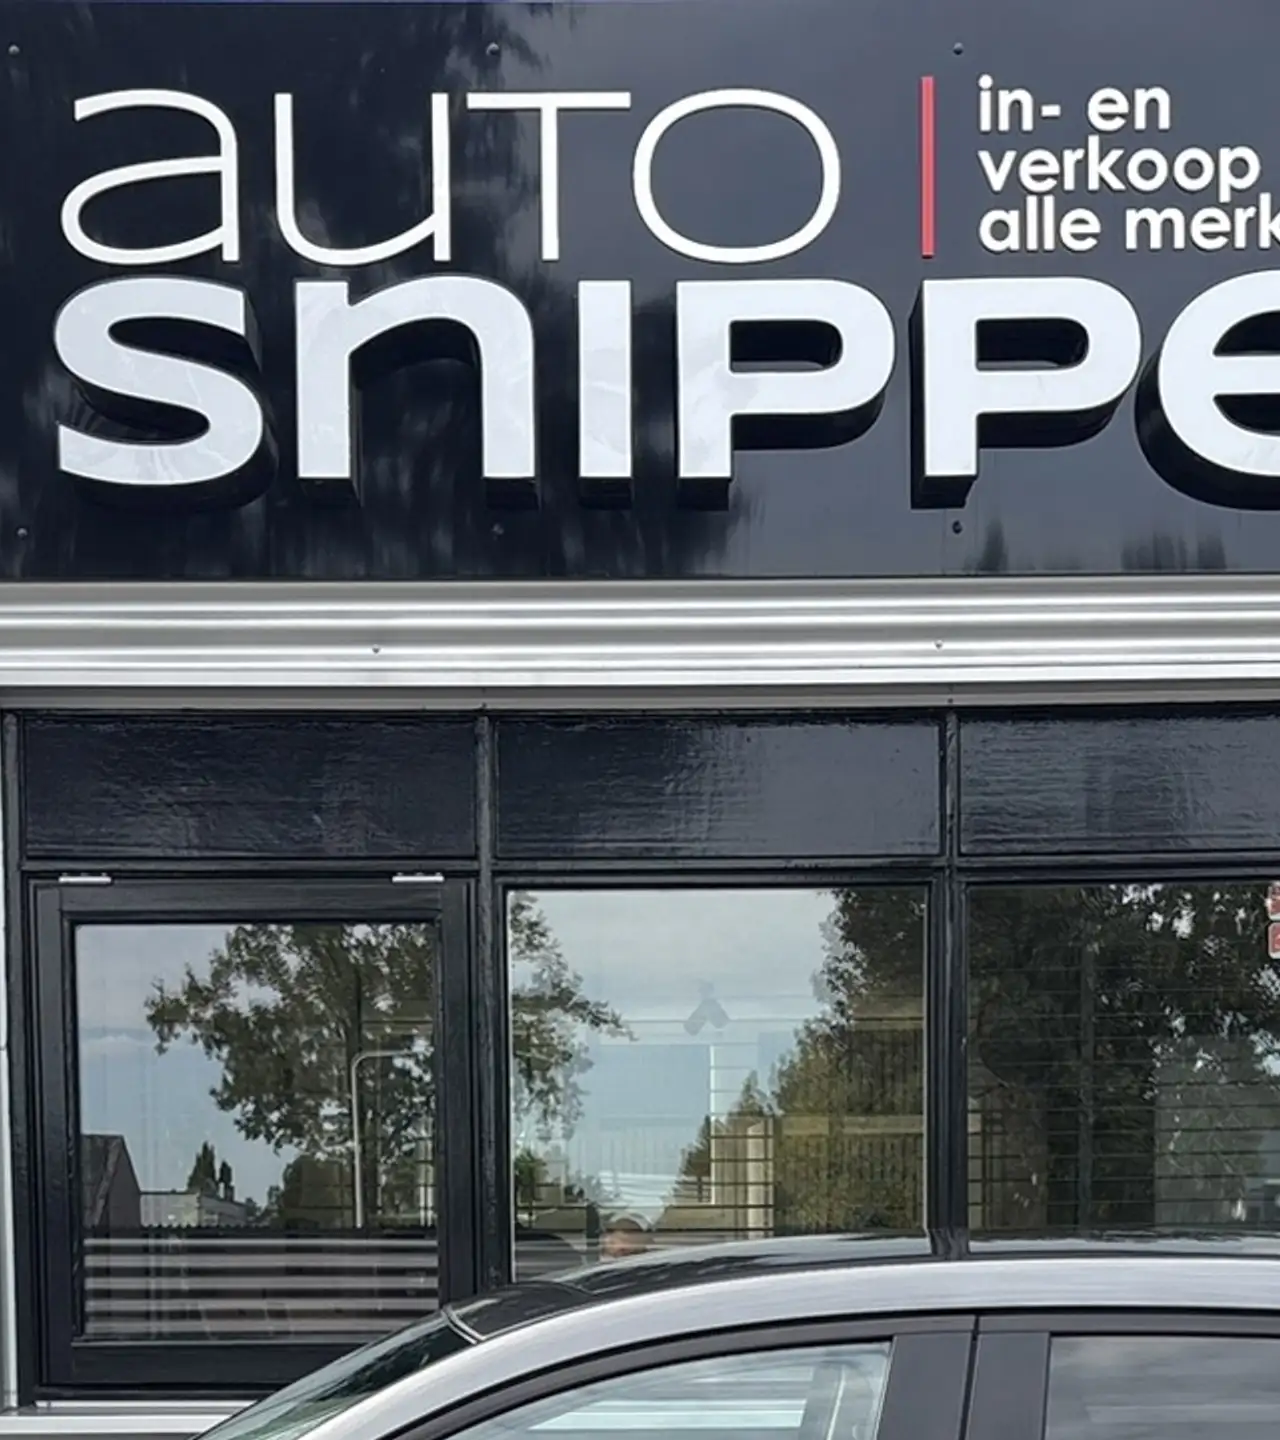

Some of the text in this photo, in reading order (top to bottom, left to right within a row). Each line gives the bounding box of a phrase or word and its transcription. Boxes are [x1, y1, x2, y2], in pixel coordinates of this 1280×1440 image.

[977, 73, 1172, 133] in- en
[977, 133, 1262, 203] verkoop
[978, 193, 1102, 253] alle
